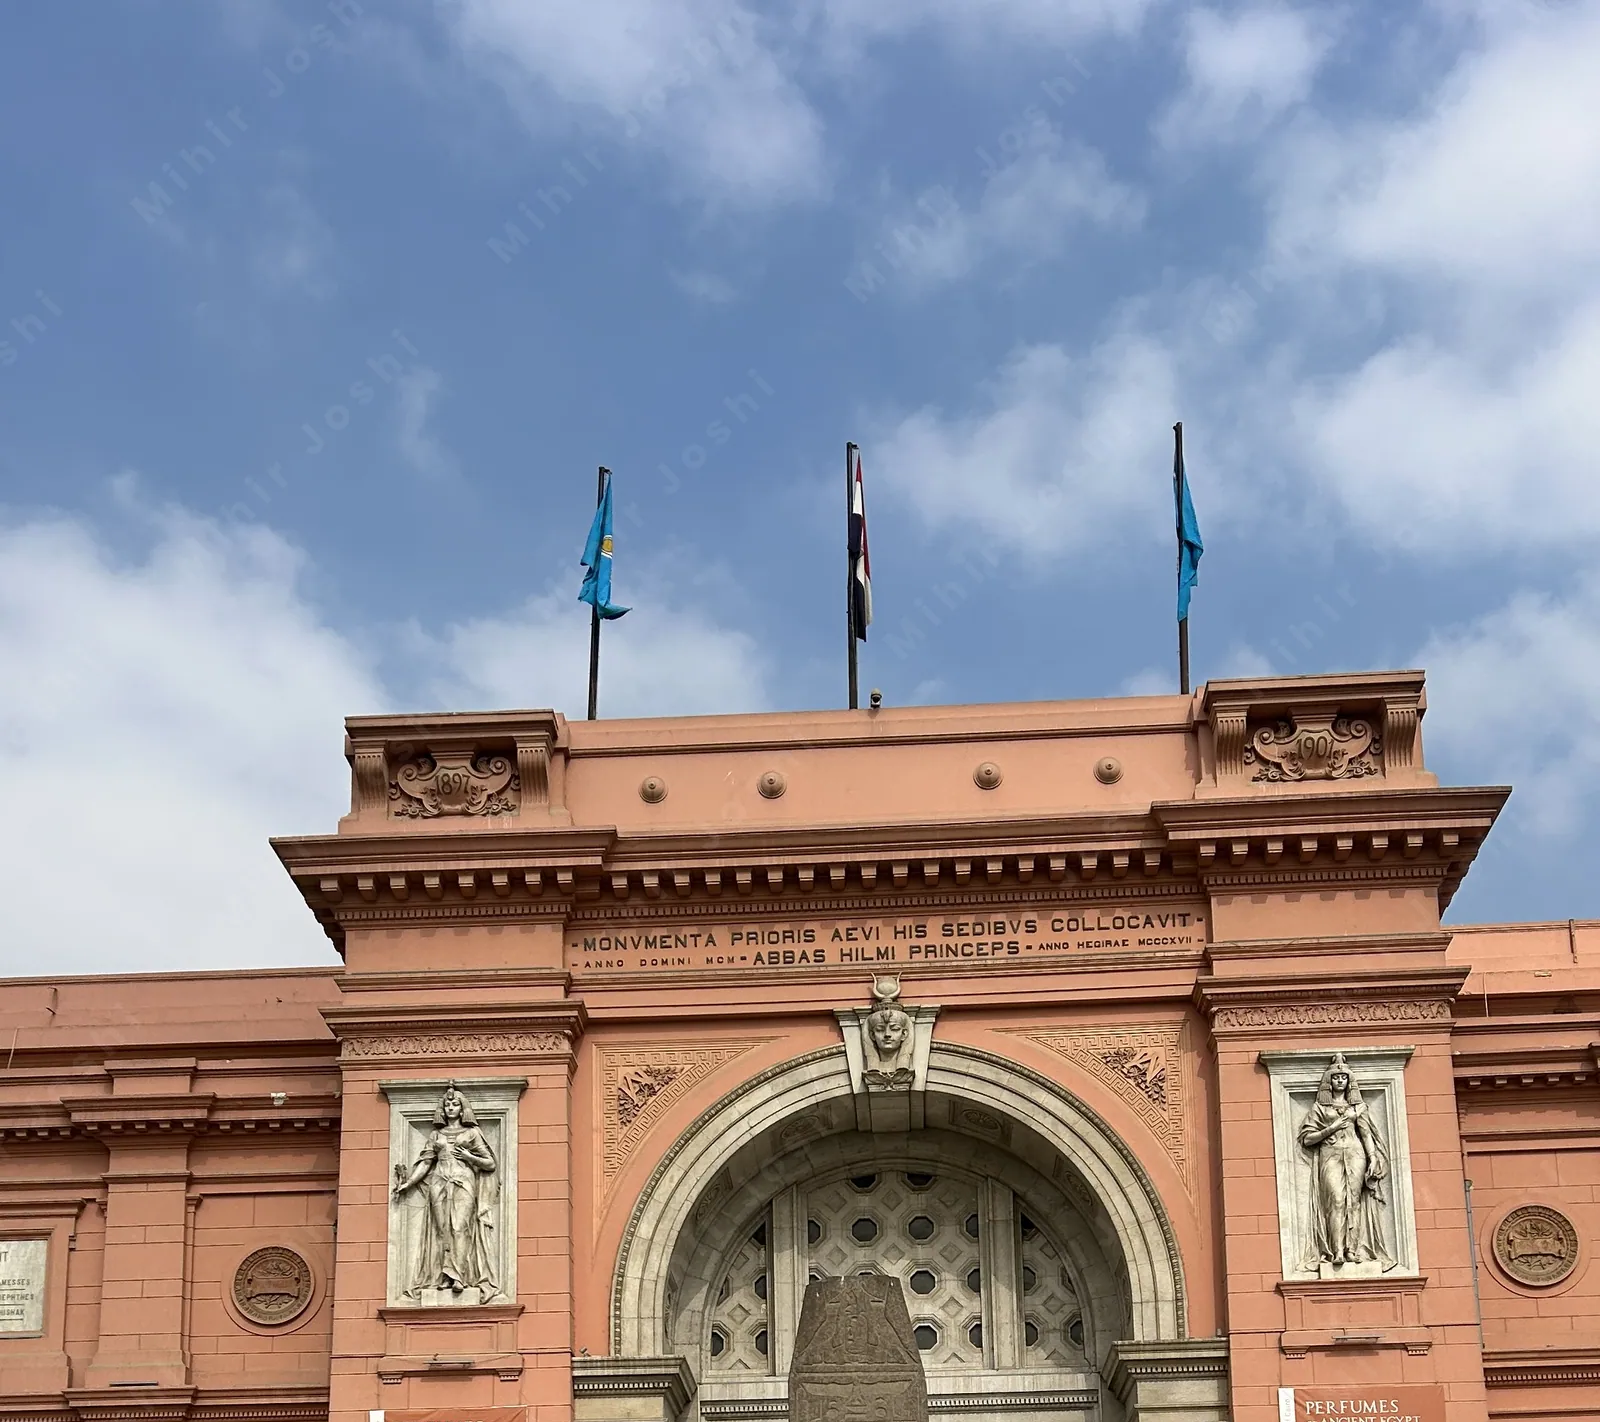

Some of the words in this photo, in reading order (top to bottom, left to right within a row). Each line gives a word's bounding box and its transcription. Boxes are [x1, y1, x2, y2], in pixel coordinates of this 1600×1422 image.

[1296, 737, 1335, 759] 1901
[435, 773, 470, 795] 1897
[583, 933, 717, 951] MONVMENTA
[731, 928, 816, 945] PRIORIS
[831, 926, 880, 942] AEVI
[893, 923, 927, 939] HIS
[941, 919, 1038, 938] SEDIBVS
[1052, 913, 1191, 932] COLLOCAVIT
[584, 960, 624, 969] ANNO
[640, 957, 691, 967] DOMINI
[706, 955, 735, 965] MCM
[753, 948, 826, 965] ABBAS
[840, 946, 895, 962] HILMI
[909, 940, 1020, 960] PRINCEPS
[1038, 942, 1069, 951] ANNO
[1077, 939, 1129, 949] HEGIRAE
[1138, 936, 1192, 946] MCCCXVII
[1305, 1399, 1399, 1415] PERFUMES
